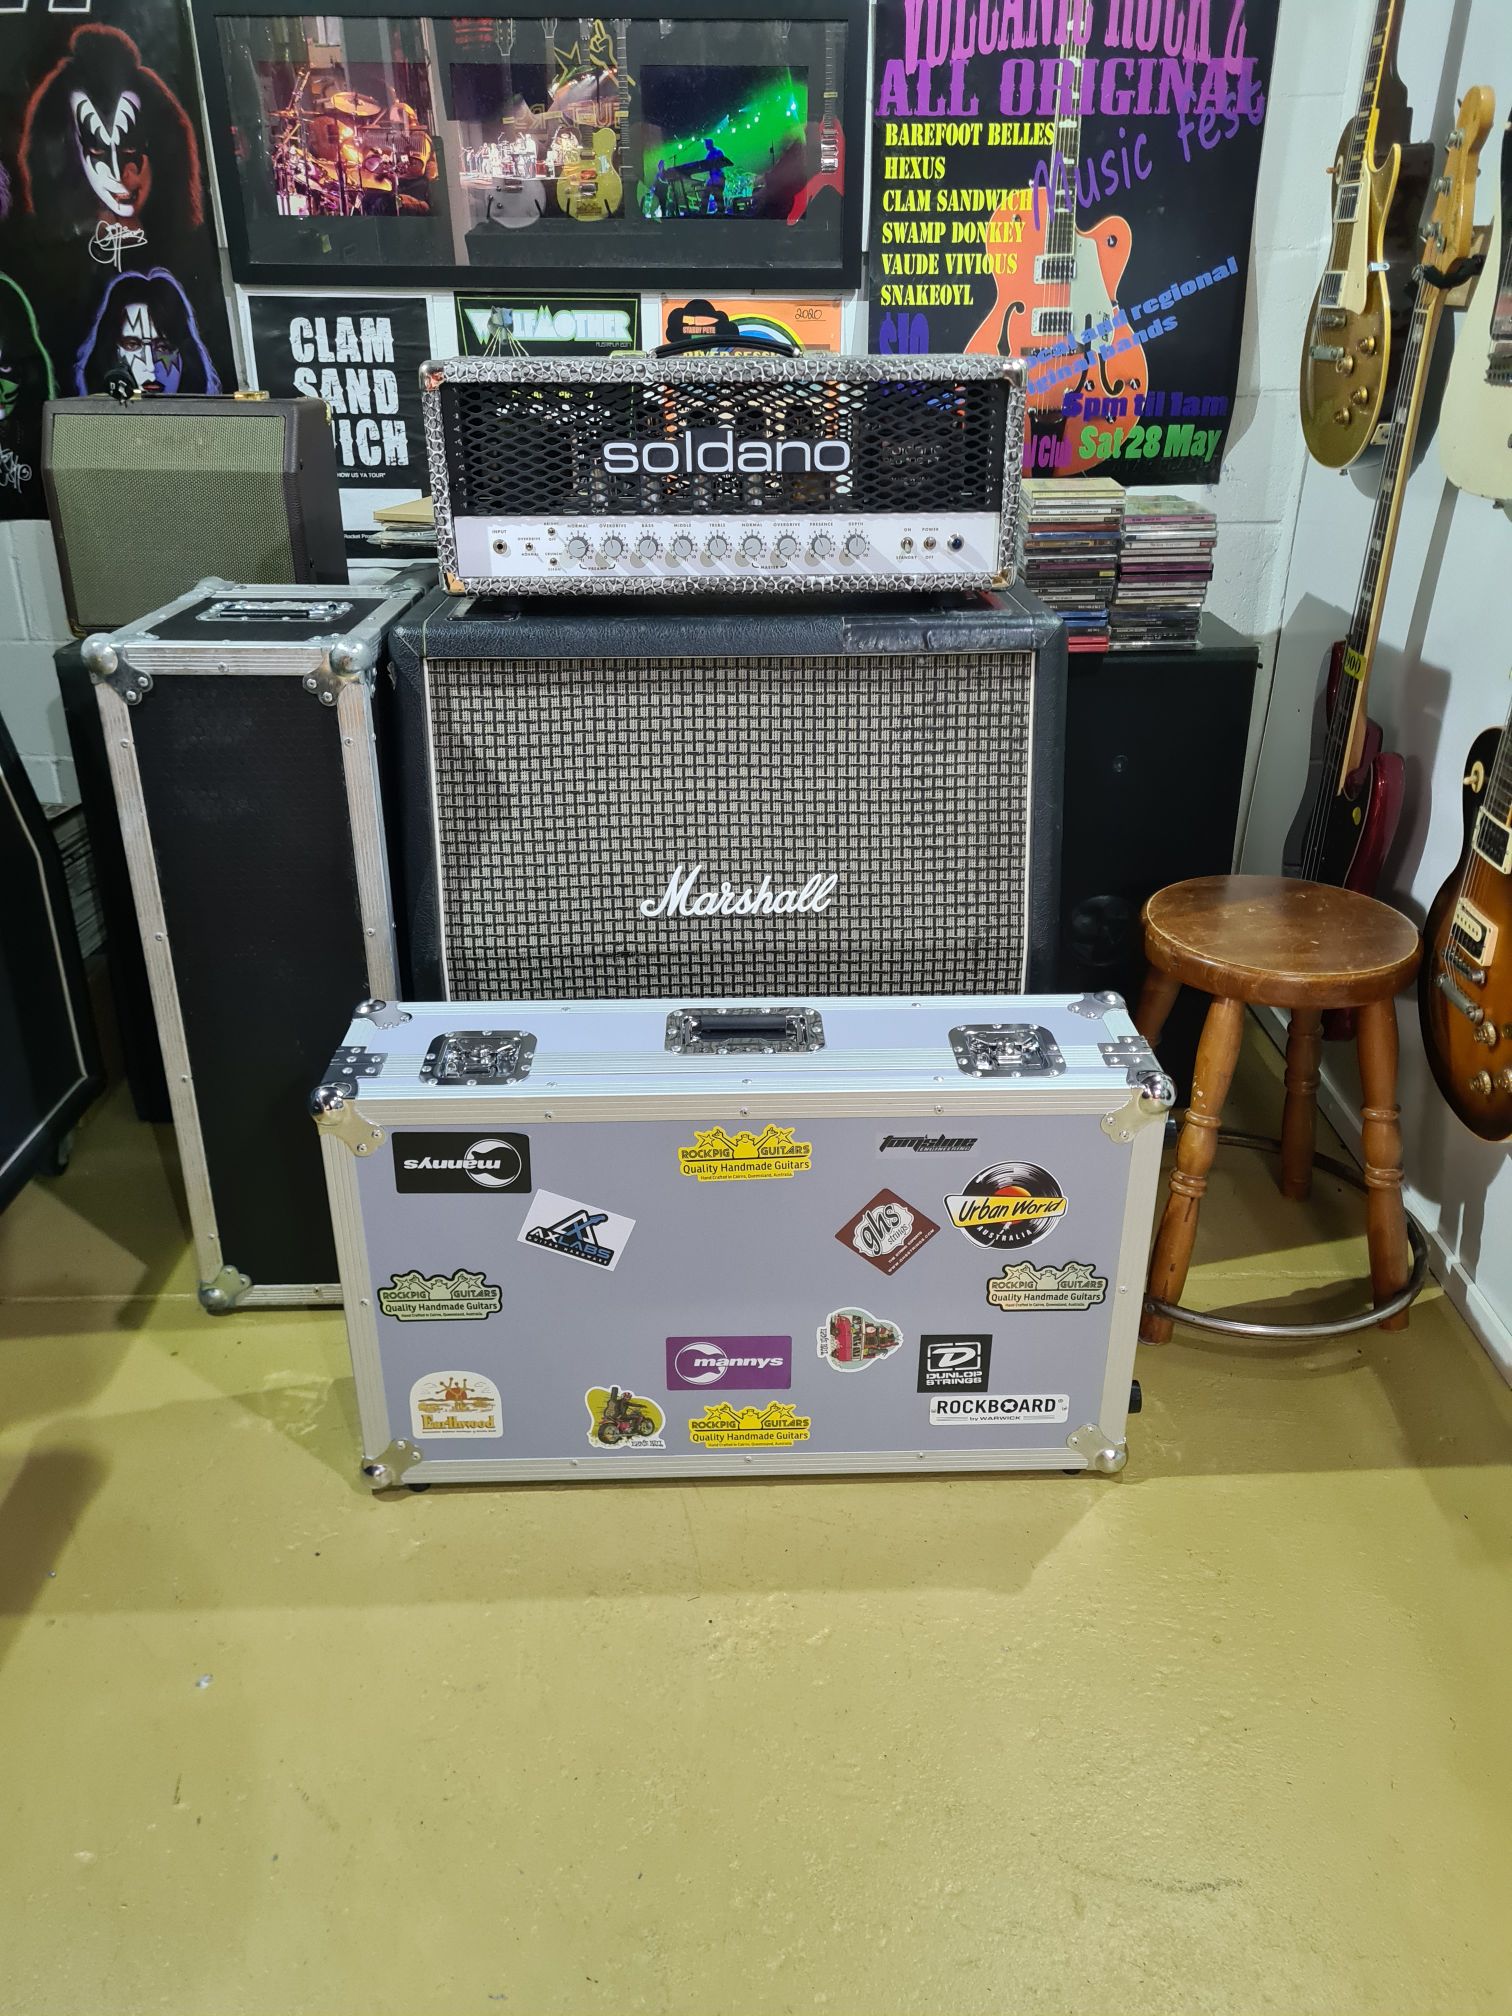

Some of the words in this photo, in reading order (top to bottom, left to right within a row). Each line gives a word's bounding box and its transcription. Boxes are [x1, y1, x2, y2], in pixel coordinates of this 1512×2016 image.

[875, 58, 979, 116] ALL
[1000, 57, 1265, 116] ORIGINAL
[885, 123, 983, 146] BAREFOOT
[988, 122, 1055, 145] BELLES
[1032, 127, 1152, 231] Music
[1178, 80, 1265, 162] fest
[884, 157, 945, 179] HEXUS
[882, 190, 931, 211] CLAM
[937, 189, 1033, 211] SANDWICH
[882, 222, 946, 243] SWAMP
[952, 222, 1026, 243] DONKEY
[882, 254, 939, 274] VAUDE
[945, 254, 1018, 274] VIVIOUS
[881, 284, 973, 305] SNAKEOYL
[1026, 332, 1078, 369] ocal
[1081, 308, 1128, 343] and
[1131, 256, 1239, 321] regional
[464, 304, 633, 345] WLFMOTHER
[289, 317, 395, 363] CLAM
[1027, 351, 1097, 395] iginal
[1100, 315, 1178, 361] bands
[293, 367, 399, 414] SAND
[331, 419, 409, 466] ICH
[603, 430, 852, 474] soldano
[1079, 426, 1124, 460] Sat
[1124, 426, 1163, 459] 28
[1163, 424, 1222, 463] May
[640, 864, 839, 917] Marshall
[681, 1148, 730, 1159] ROCKPIG
[760, 1144, 810, 1156] GUITARS
[403, 1156, 502, 1171] mannys
[683, 1164, 718, 1175] Quality
[720, 1161, 772, 1173] Handmade
[774, 1158, 810, 1170] Guitars
[958, 1197, 1010, 1222] Urban
[1012, 1198, 1064, 1217] World
[862, 1205, 900, 1255] ghs
[887, 1223, 909, 1245] strings
[977, 1225, 1033, 1242] AUSTRALIA
[527, 1235, 559, 1249] GUITAR
[530, 1227, 612, 1260] AXLABS
[382, 1291, 427, 1299] ROCKPIG
[453, 1289, 498, 1298] GUITARS
[991, 1281, 1034, 1289] ROCKPIG
[1060, 1280, 1104, 1289] GUITARS
[385, 1304, 416, 1313] Quality
[418, 1302, 465, 1312] Handmade
[466, 1302, 498, 1310] Guitars
[991, 1293, 1021, 1303] Quality
[1024, 1292, 1069, 1301] Handmade
[1070, 1293, 1101, 1301] Guitars
[693, 1356, 784, 1369] mannys
[926, 1371, 983, 1380] DUNLOP
[926, 1377, 982, 1386] STRINGS
[936, 1398, 1056, 1414] ROCKBOARD
[421, 1415, 496, 1430] Earthwood
[691, 1421, 736, 1429] ROCKPIG
[764, 1419, 810, 1428] GUITARS
[692, 1433, 725, 1442] Quality
[727, 1432, 774, 1441] Handmade
[776, 1431, 808, 1440] Guitars
